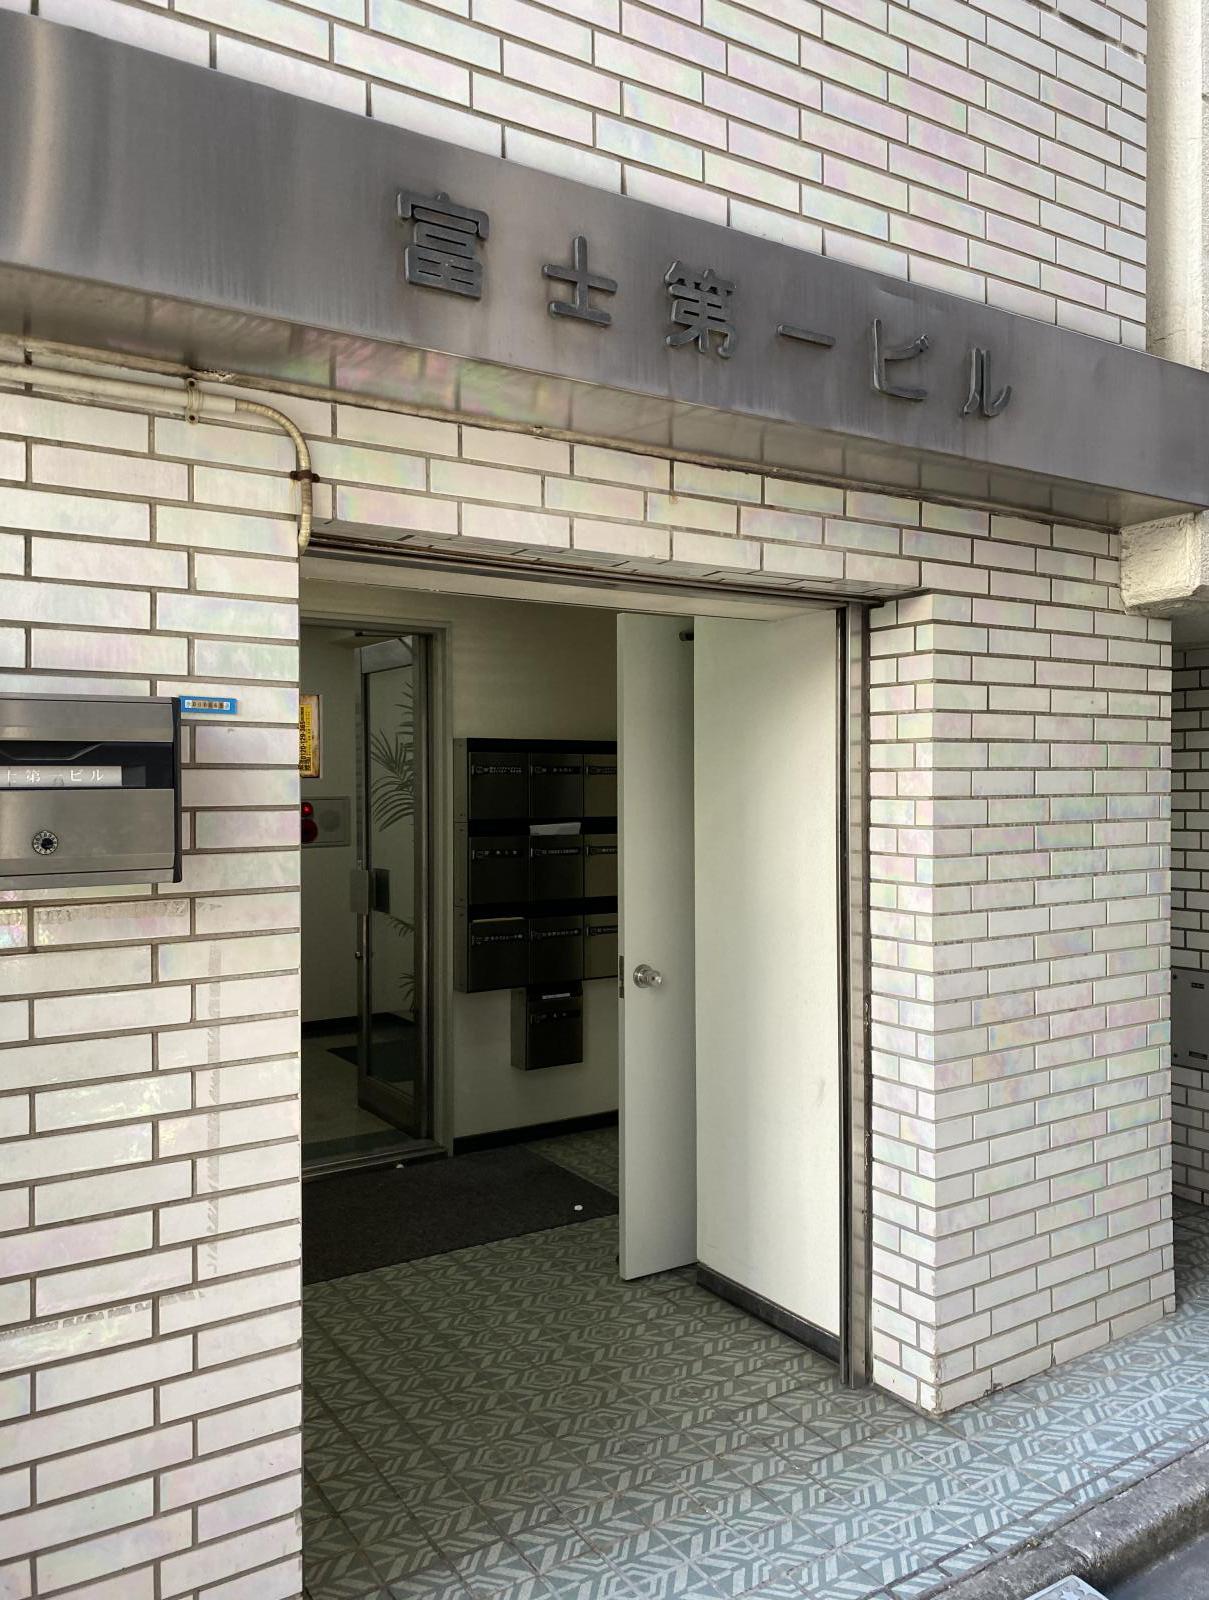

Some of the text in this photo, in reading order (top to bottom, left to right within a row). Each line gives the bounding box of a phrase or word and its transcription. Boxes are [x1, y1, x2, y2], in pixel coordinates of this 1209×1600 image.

[397, 191, 1012, 418] 富士第一ビル
